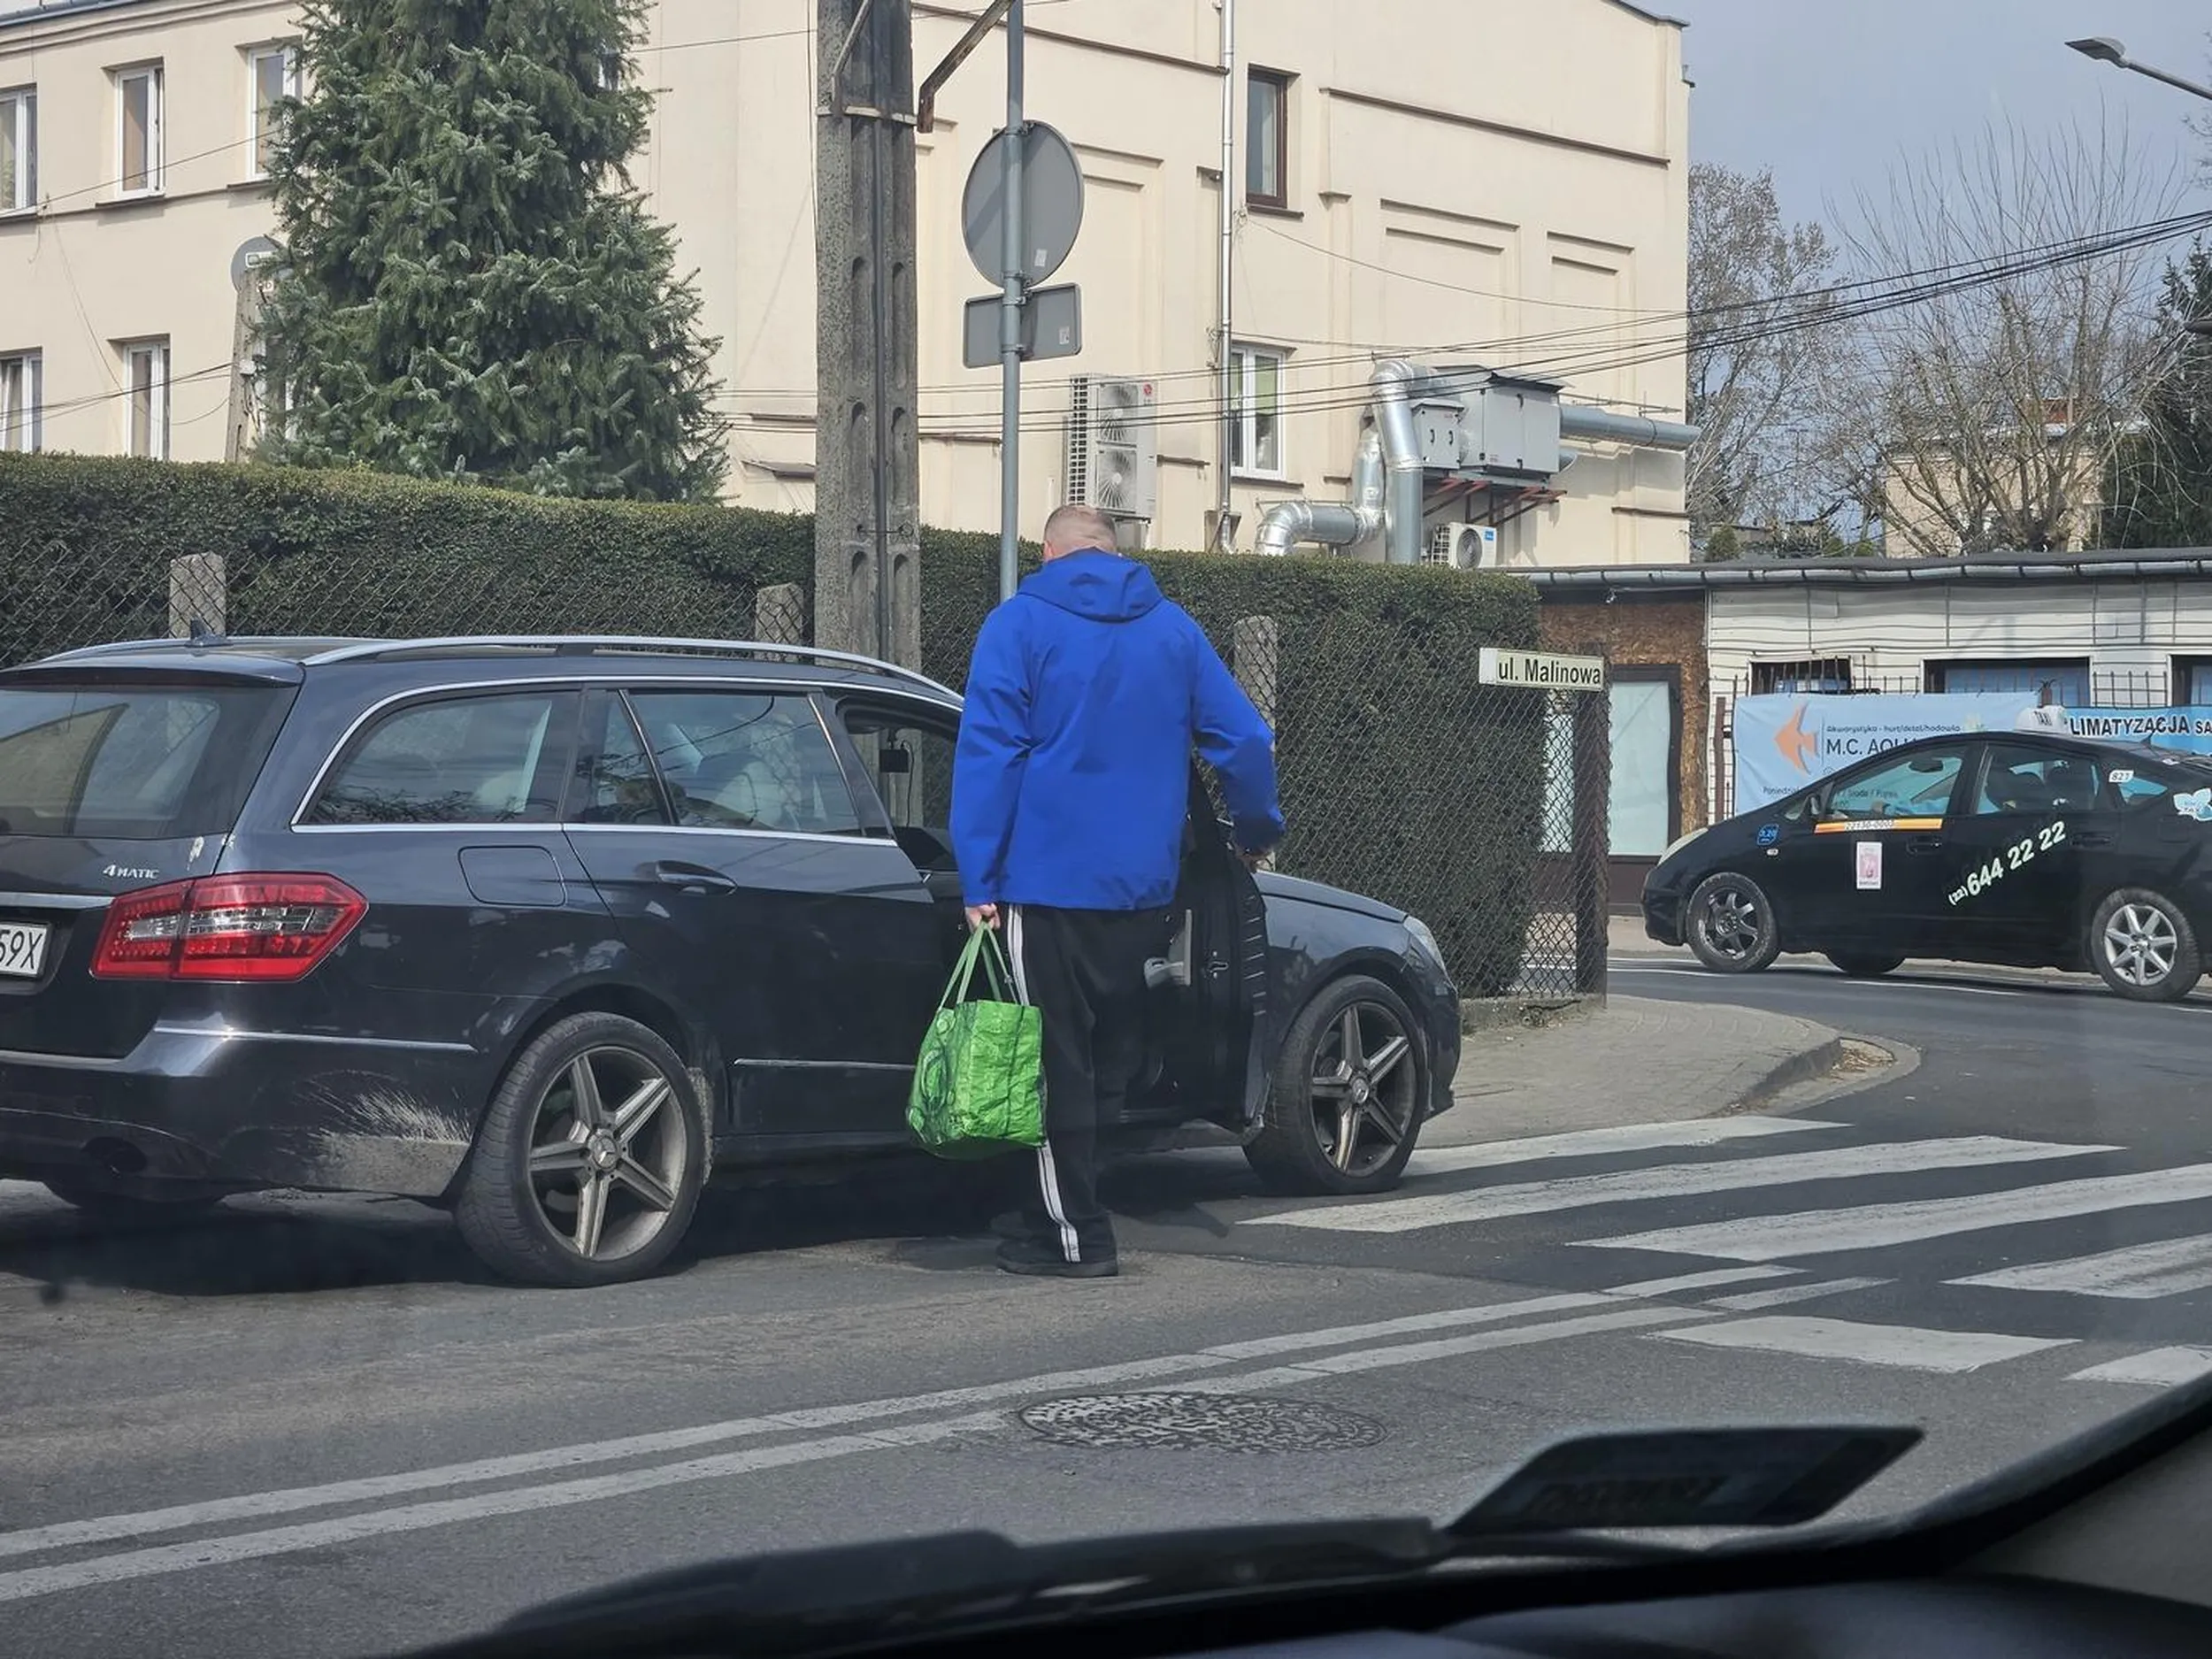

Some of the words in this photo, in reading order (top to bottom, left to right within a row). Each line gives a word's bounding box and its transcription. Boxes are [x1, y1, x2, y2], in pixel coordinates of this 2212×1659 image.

[1498, 657, 1518, 680] ul.
[1525, 658, 1601, 684] Malinowa
[2064, 715, 2190, 736] LIMATYZACJA
[1826, 738, 1863, 755] M.C.
[1967, 857, 2004, 895] 644
[2007, 838, 2035, 870] 22
[2039, 821, 2066, 851] 22
[103, 864, 160, 879] 4MATIC
